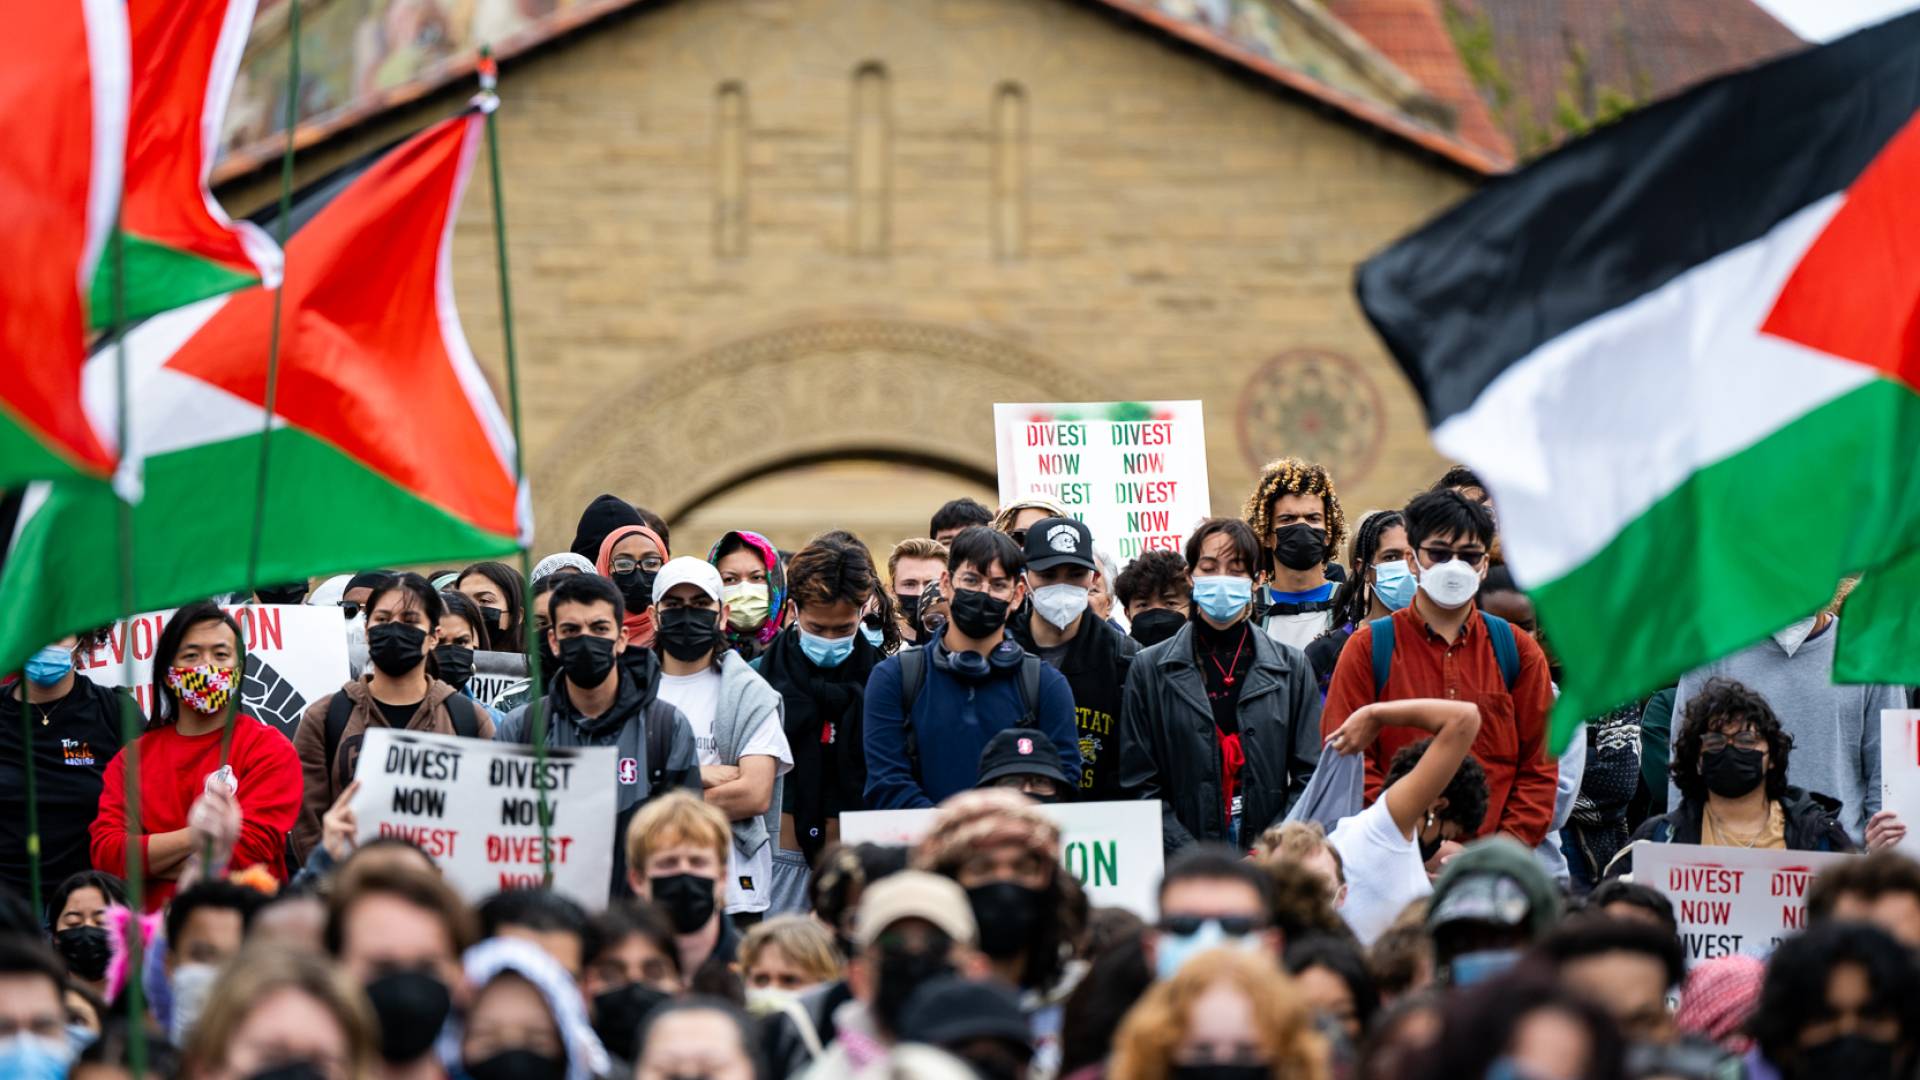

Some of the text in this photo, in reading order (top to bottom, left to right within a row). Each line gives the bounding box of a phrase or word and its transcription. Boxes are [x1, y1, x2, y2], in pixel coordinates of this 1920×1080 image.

[1027, 424, 1088, 446] DIVEST
[1112, 423, 1173, 445] DIVEST
[1038, 454, 1080, 475] NOW
[1123, 453, 1164, 474] NOW
[1115, 481, 1178, 504] DIVEST
[1127, 510, 1169, 533] NOW
[385, 745, 462, 781] DIVEST
[489, 759, 574, 790] DIVEST
[392, 787, 446, 818] NOW
[486, 835, 574, 864] DIVEST
[1669, 868, 1744, 894] DIVEST
[1681, 900, 1731, 925] NOW
[1683, 933, 1743, 959] IVEST
